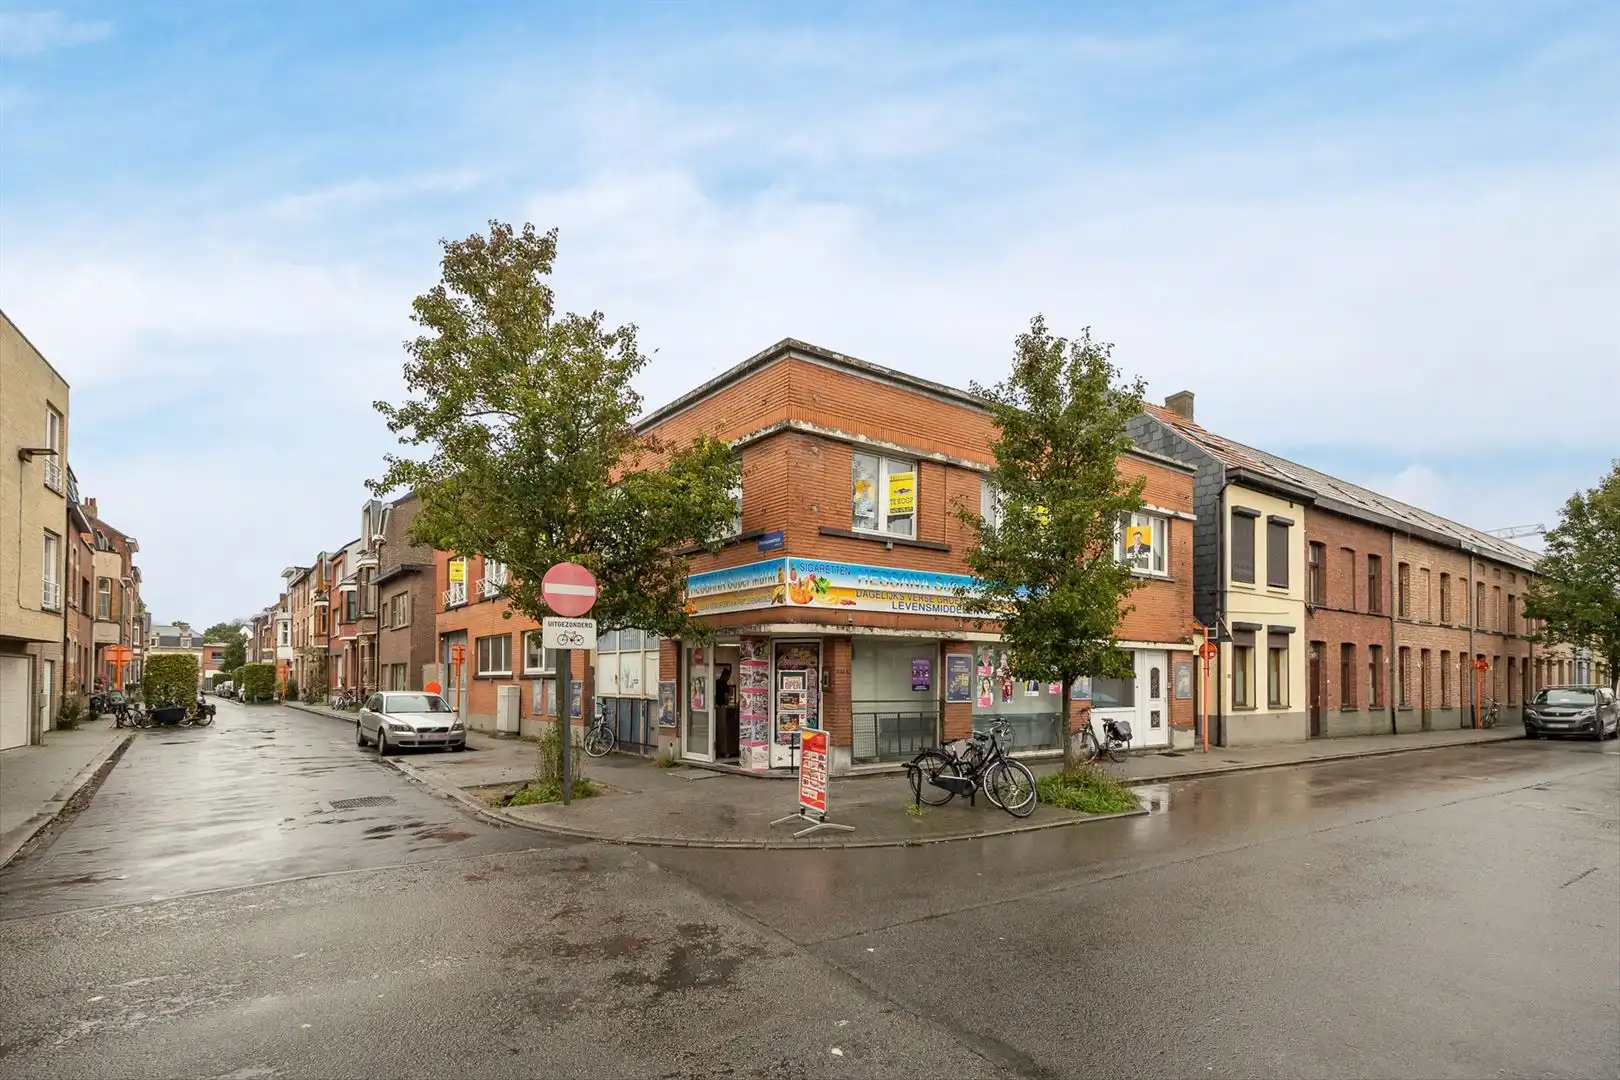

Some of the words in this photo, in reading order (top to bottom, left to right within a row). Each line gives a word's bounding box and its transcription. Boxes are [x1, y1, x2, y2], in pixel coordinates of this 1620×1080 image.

[799, 562, 851, 576] SIGARETTEN
[856, 589, 905, 601] DAGELIJKS
[908, 593, 934, 603] VERSE
[547, 621, 593, 629] UITGEZONDERD
